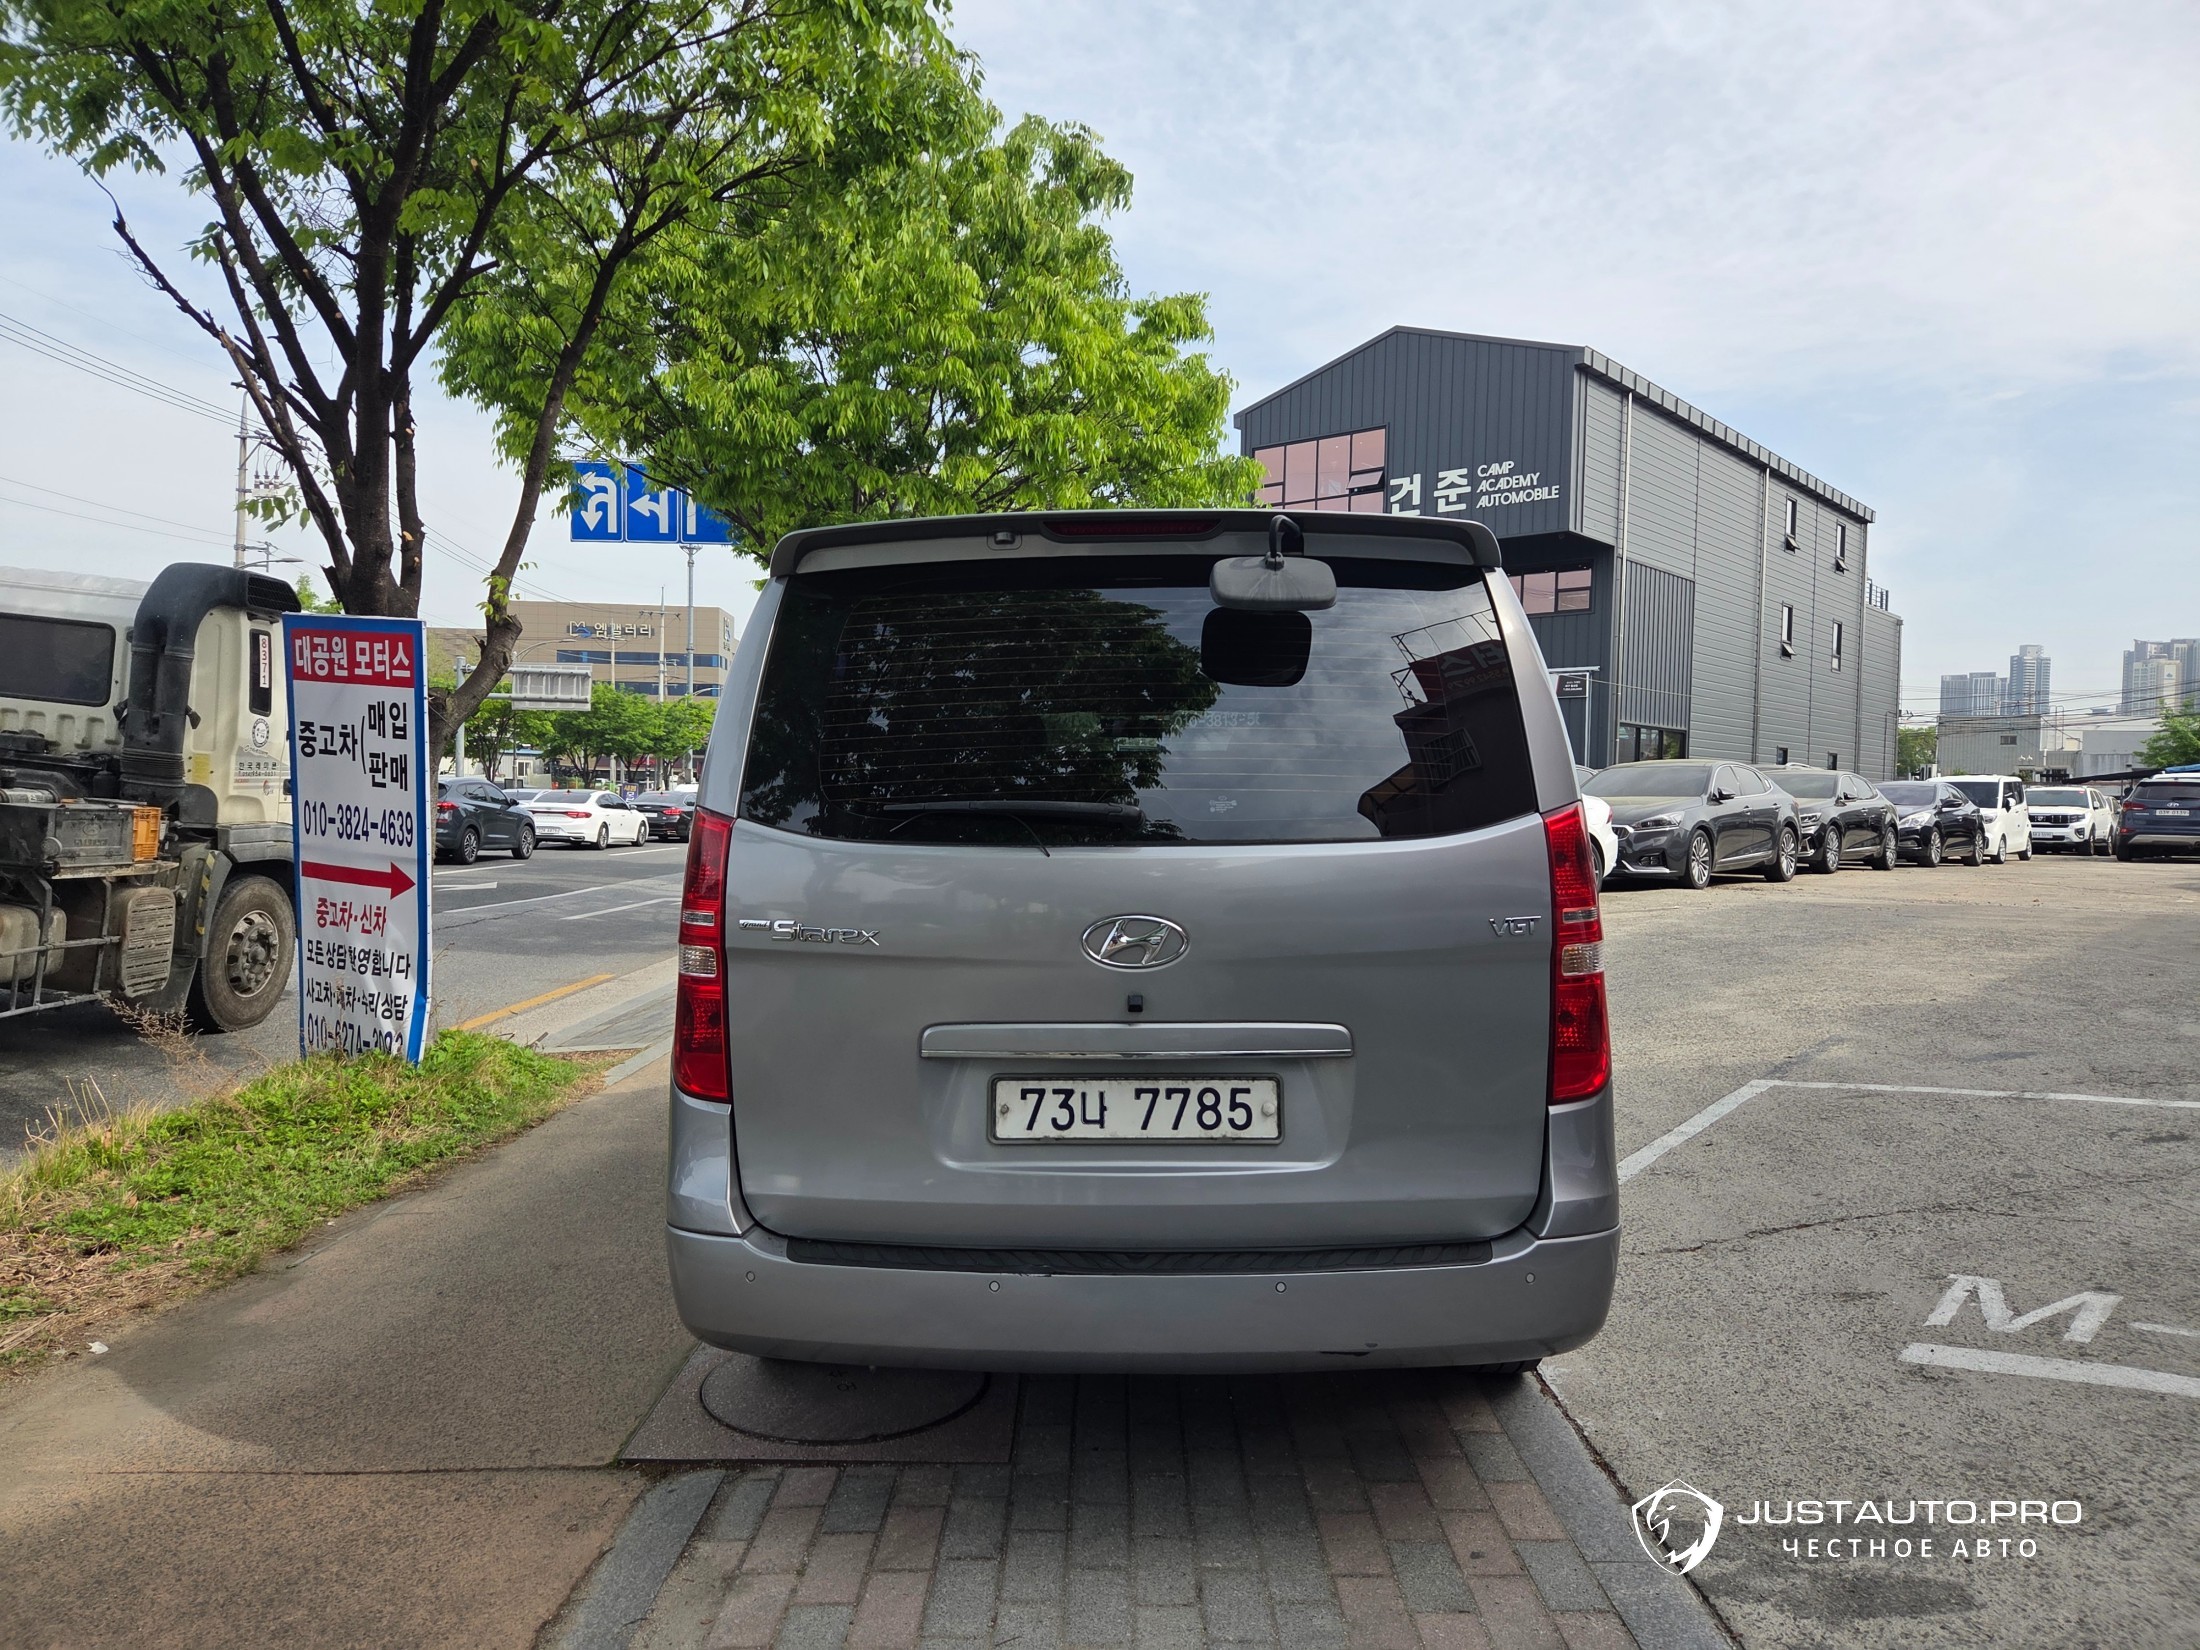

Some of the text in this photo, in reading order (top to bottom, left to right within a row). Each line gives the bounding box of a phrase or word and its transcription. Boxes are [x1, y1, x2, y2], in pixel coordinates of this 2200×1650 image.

[1477, 461, 1514, 477] CAMP
[1477, 472, 1540, 493] ACADEMY
[1476, 485, 1560, 508] AUTOMOBILE
[594, 622, 652, 639] 엠갤러리
[295, 635, 411, 680] 대공원 모터스
[368, 700, 408, 740] 매입
[368, 752, 408, 791] 판매
[303, 799, 413, 847] 010-3824-4639
[772, 919, 880, 946] Starex
[1489, 915, 1541, 937] VGT
[1020, 1087, 1252, 1131] 73나 7785
